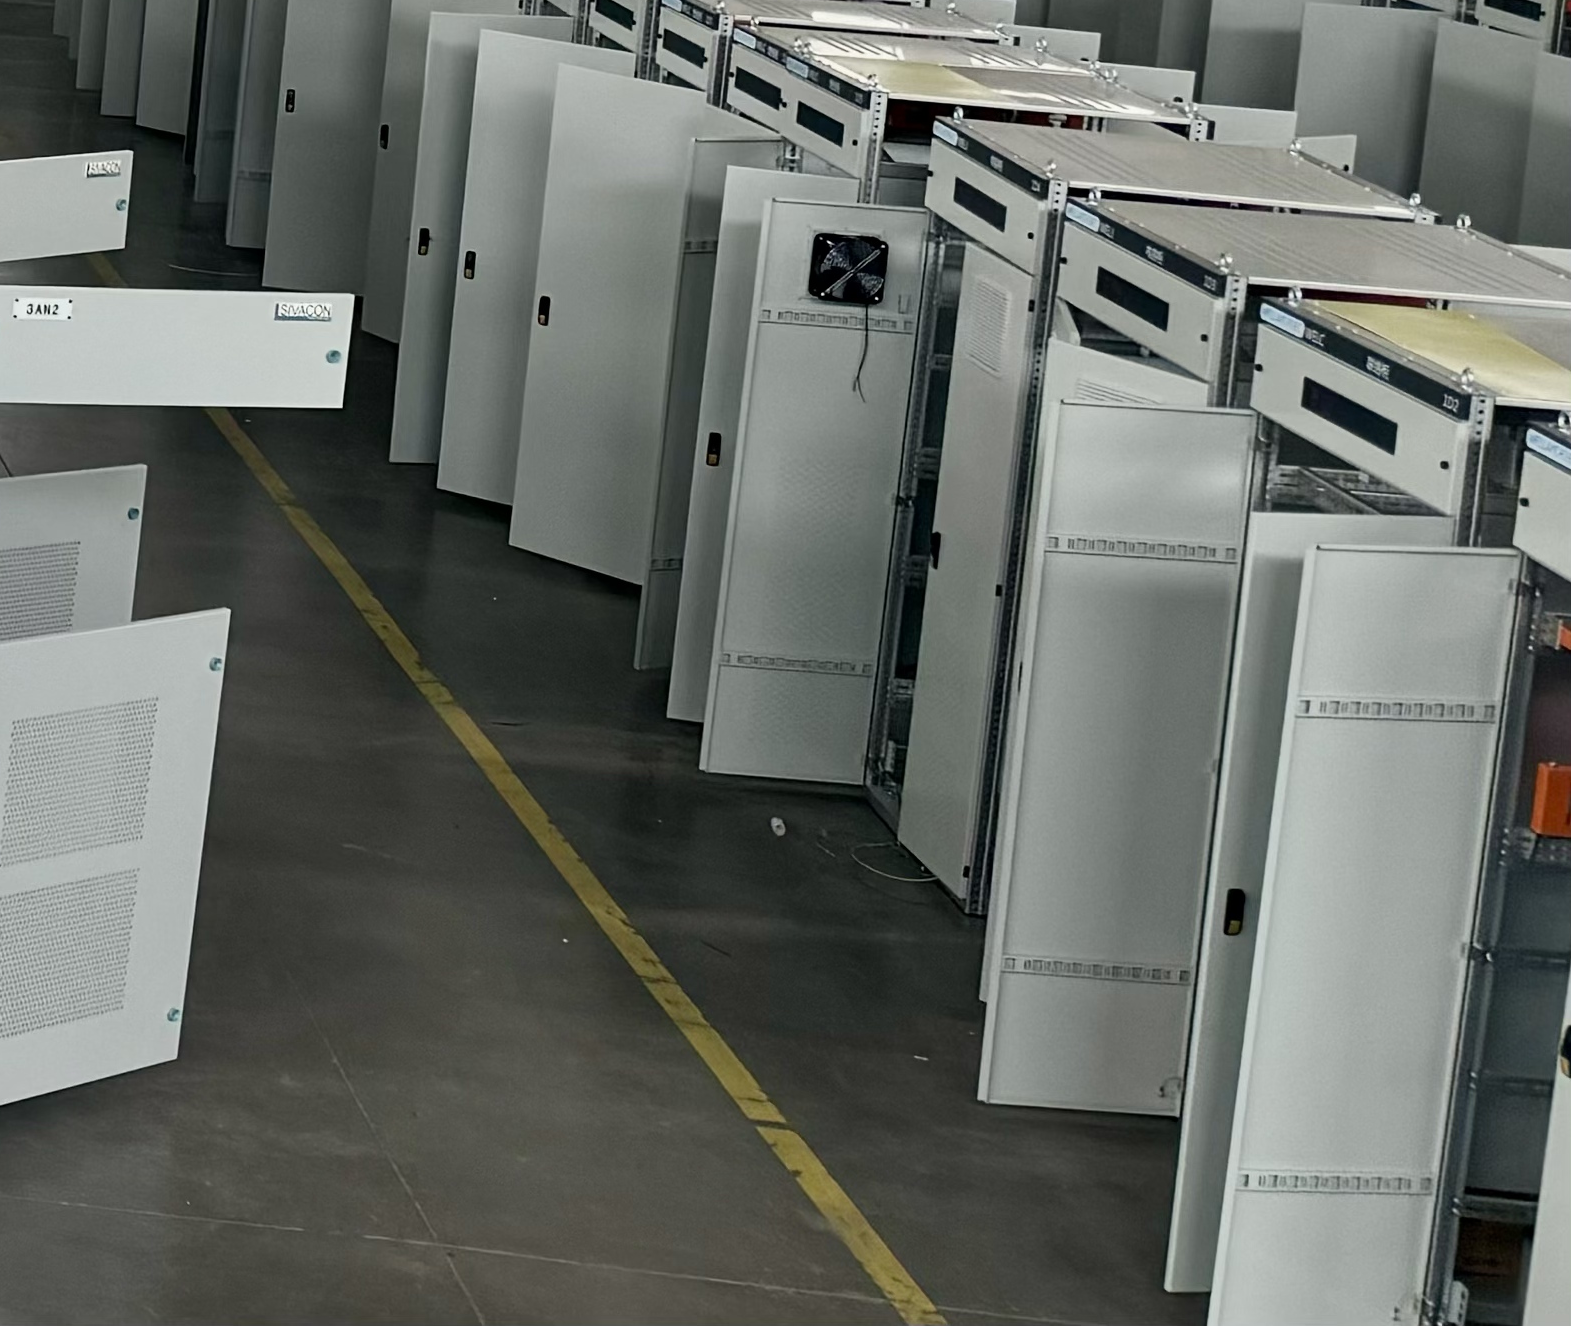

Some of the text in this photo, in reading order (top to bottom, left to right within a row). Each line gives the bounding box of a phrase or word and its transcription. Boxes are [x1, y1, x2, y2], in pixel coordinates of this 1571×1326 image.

[25, 303, 60, 316] 3AN2
[280, 303, 331, 318] SIVACON
[1443, 394, 1460, 413] 1D2
